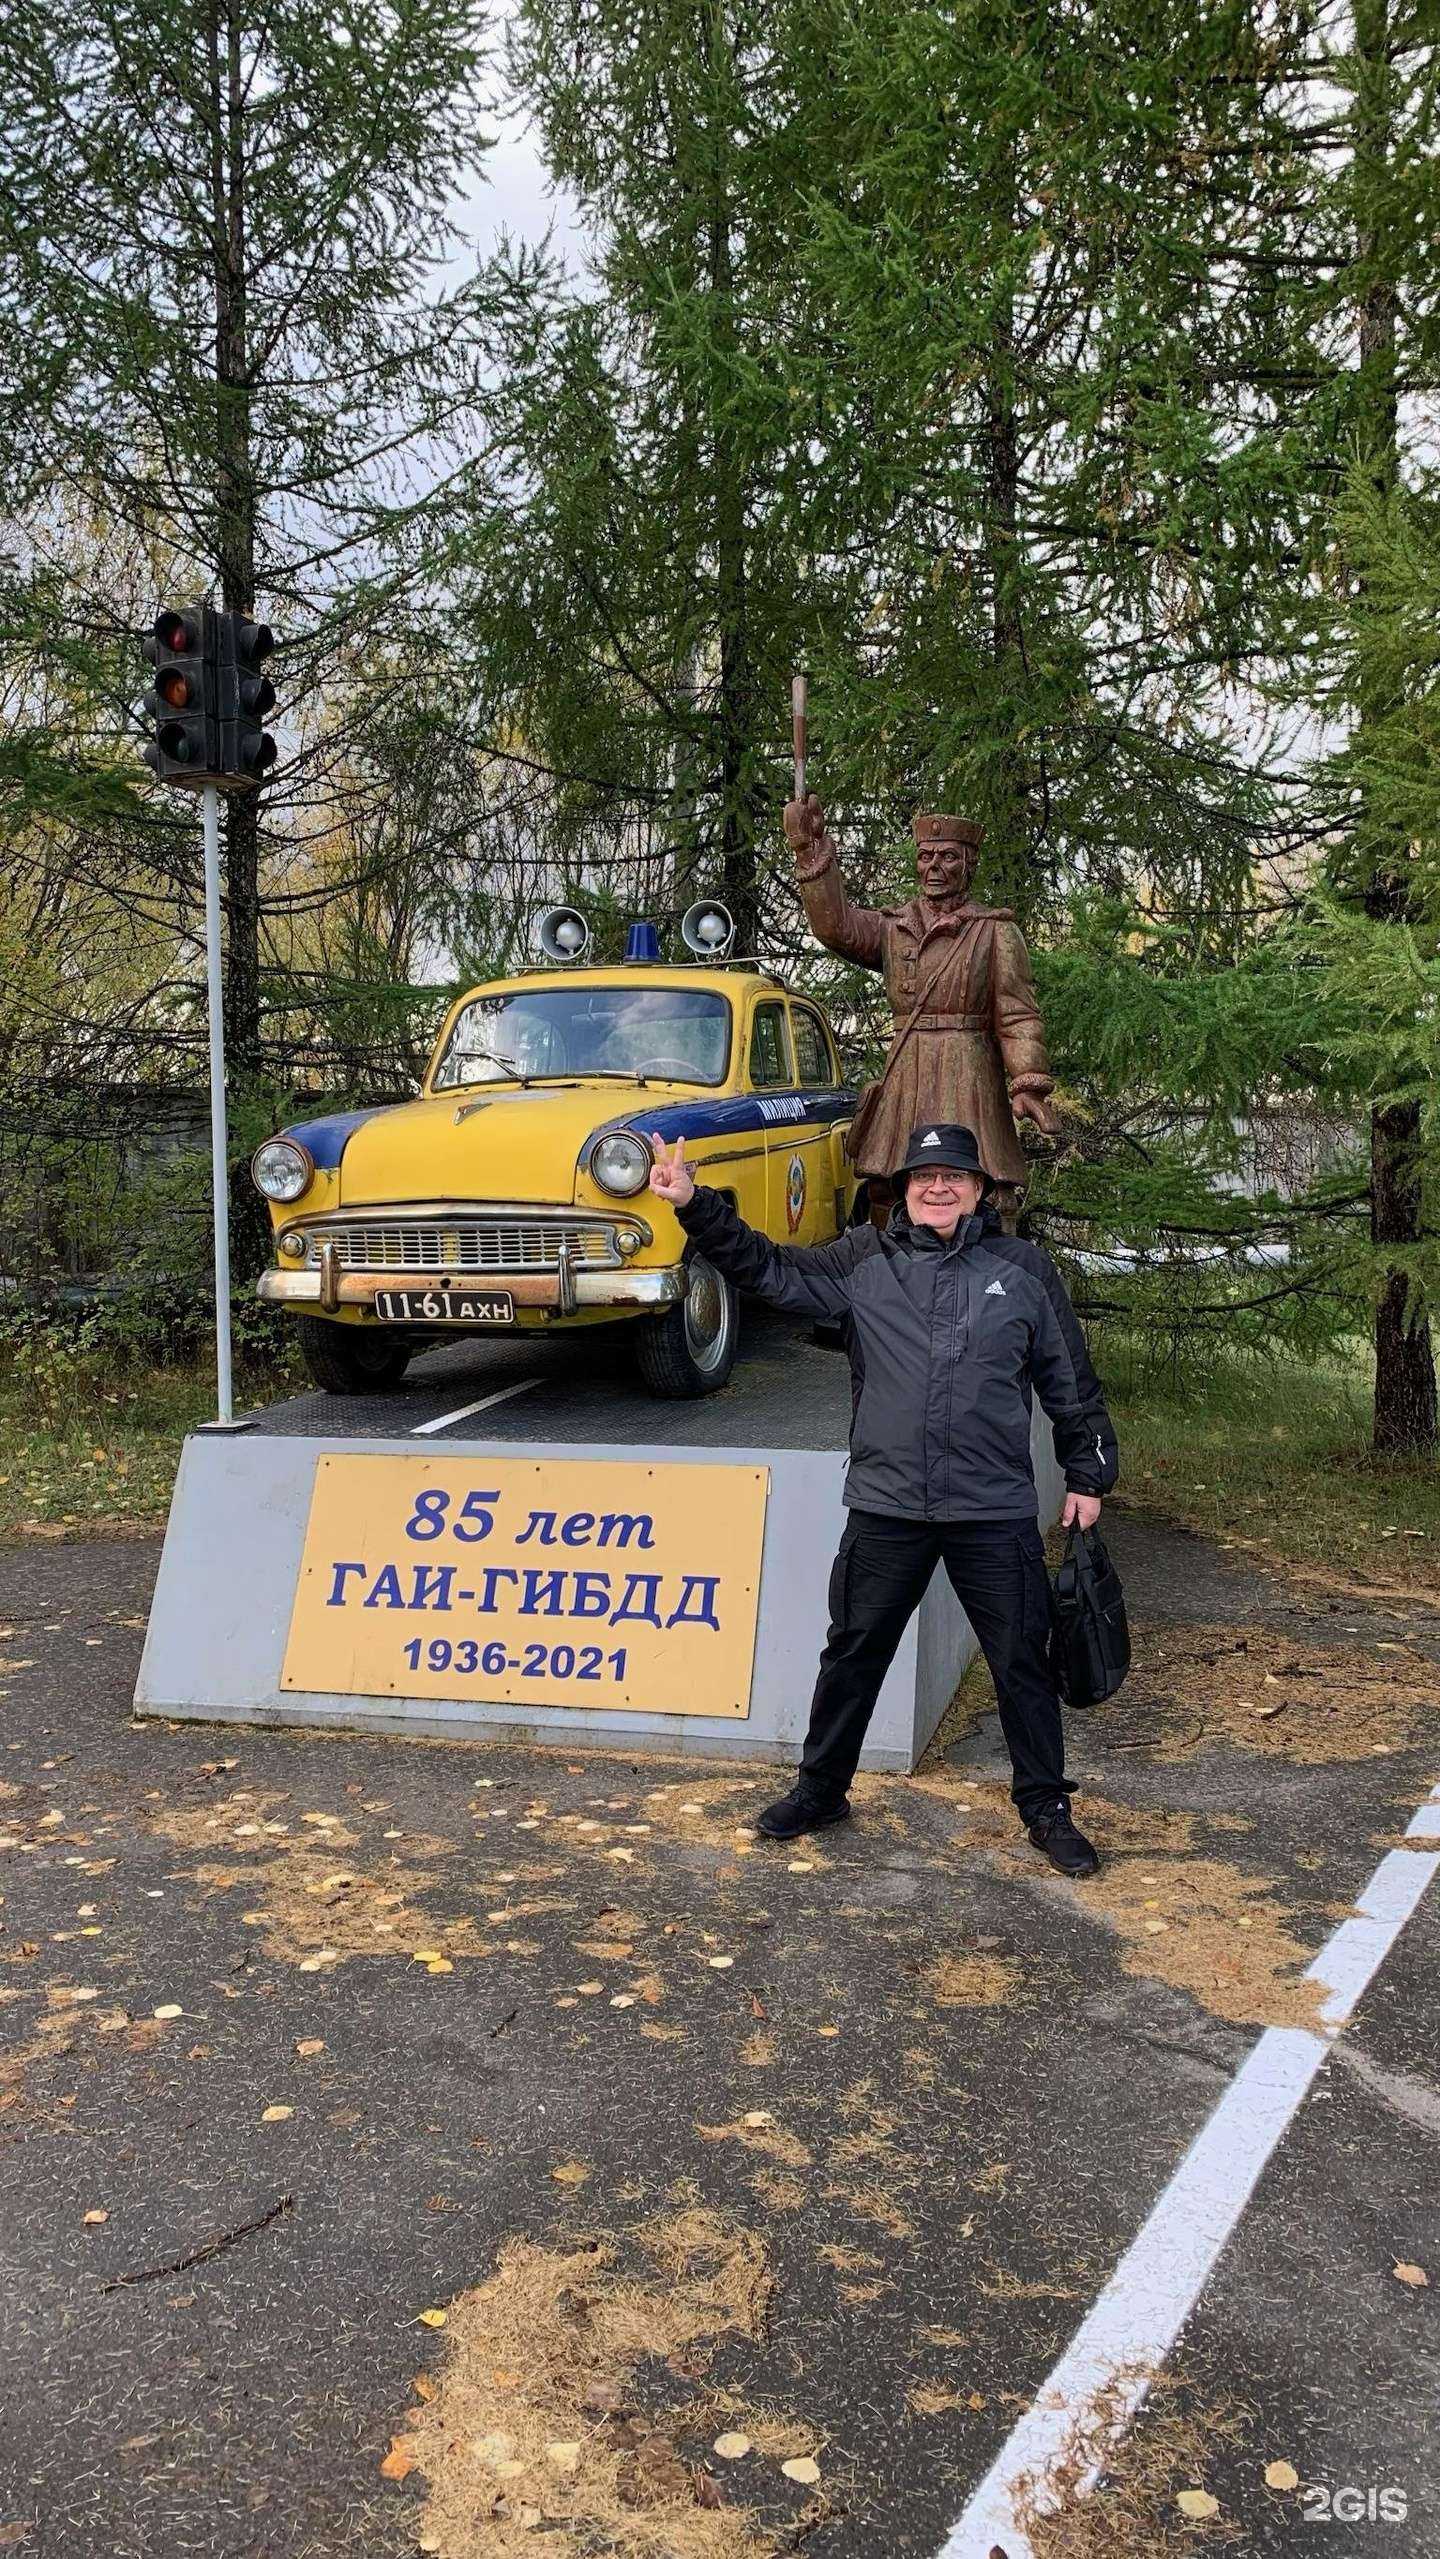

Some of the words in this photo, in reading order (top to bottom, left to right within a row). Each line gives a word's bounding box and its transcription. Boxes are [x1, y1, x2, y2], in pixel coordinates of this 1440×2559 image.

[383, 1293, 453, 1318] 11-61
[460, 1303, 508, 1319] АХН
[405, 1489, 501, 1542] 85
[515, 1511, 655, 1549] лет
[326, 1562, 721, 1631] ГАИ-ГИБДД
[403, 1638, 628, 1681] 1936-2021
